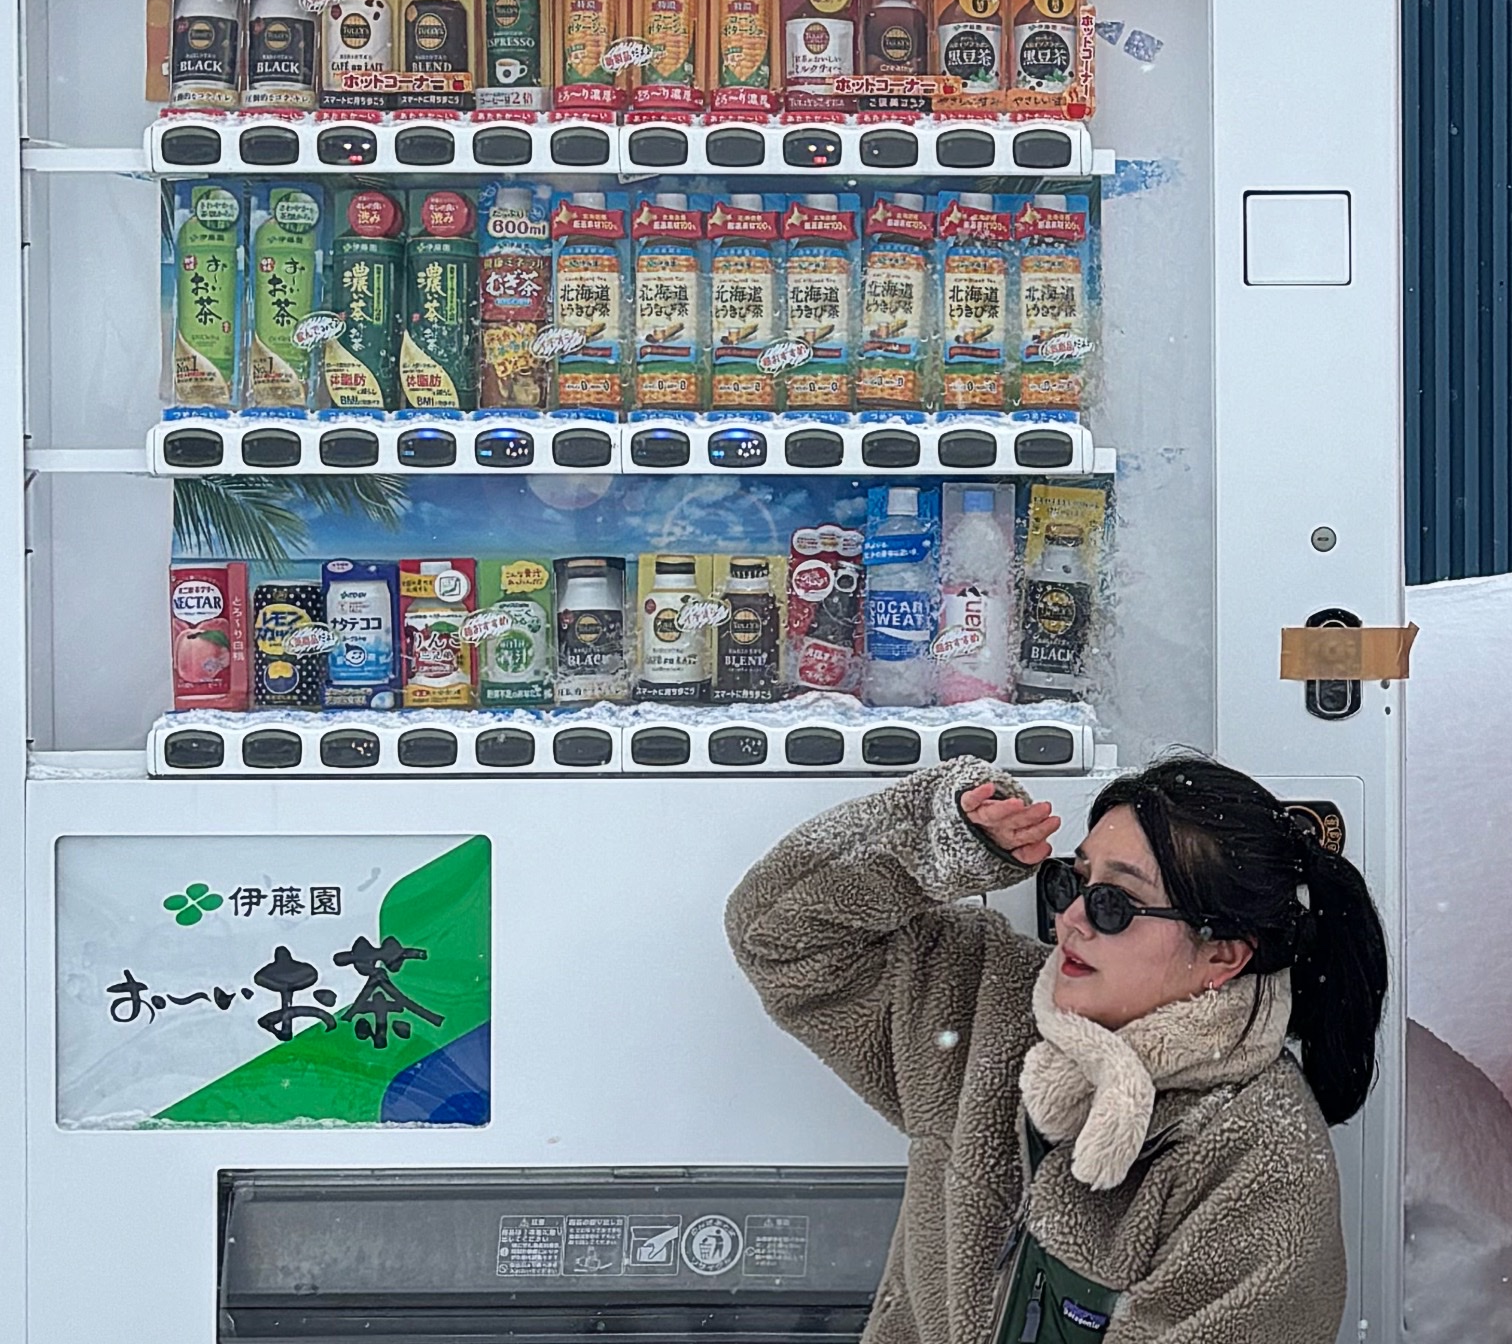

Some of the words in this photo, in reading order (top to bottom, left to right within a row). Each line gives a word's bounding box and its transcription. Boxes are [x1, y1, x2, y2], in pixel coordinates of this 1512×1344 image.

[179, 60, 222, 73] BLACK
[948, 49, 992, 67] 黒豆茶
[1023, 48, 1068, 67] 黒豆茶
[256, 61, 299, 74] BLACK
[343, 73, 445, 89] ホットコーナー
[835, 78, 937, 94] ホットコーナー
[492, 219, 547, 235] 600ml
[486, 269, 542, 297] むぎ茶
[868, 280, 914, 300] 北海道
[189, 272, 223, 324] お茶
[560, 284, 611, 302] 北海道
[639, 284, 689, 302] 北海道
[714, 284, 763, 303] 北海道
[790, 284, 840, 303] 北海道
[949, 284, 1000, 303] 北海道
[262, 611, 300, 627] レモン
[331, 617, 383, 632] ナタデココ
[228, 886, 342, 918] 伊藤園
